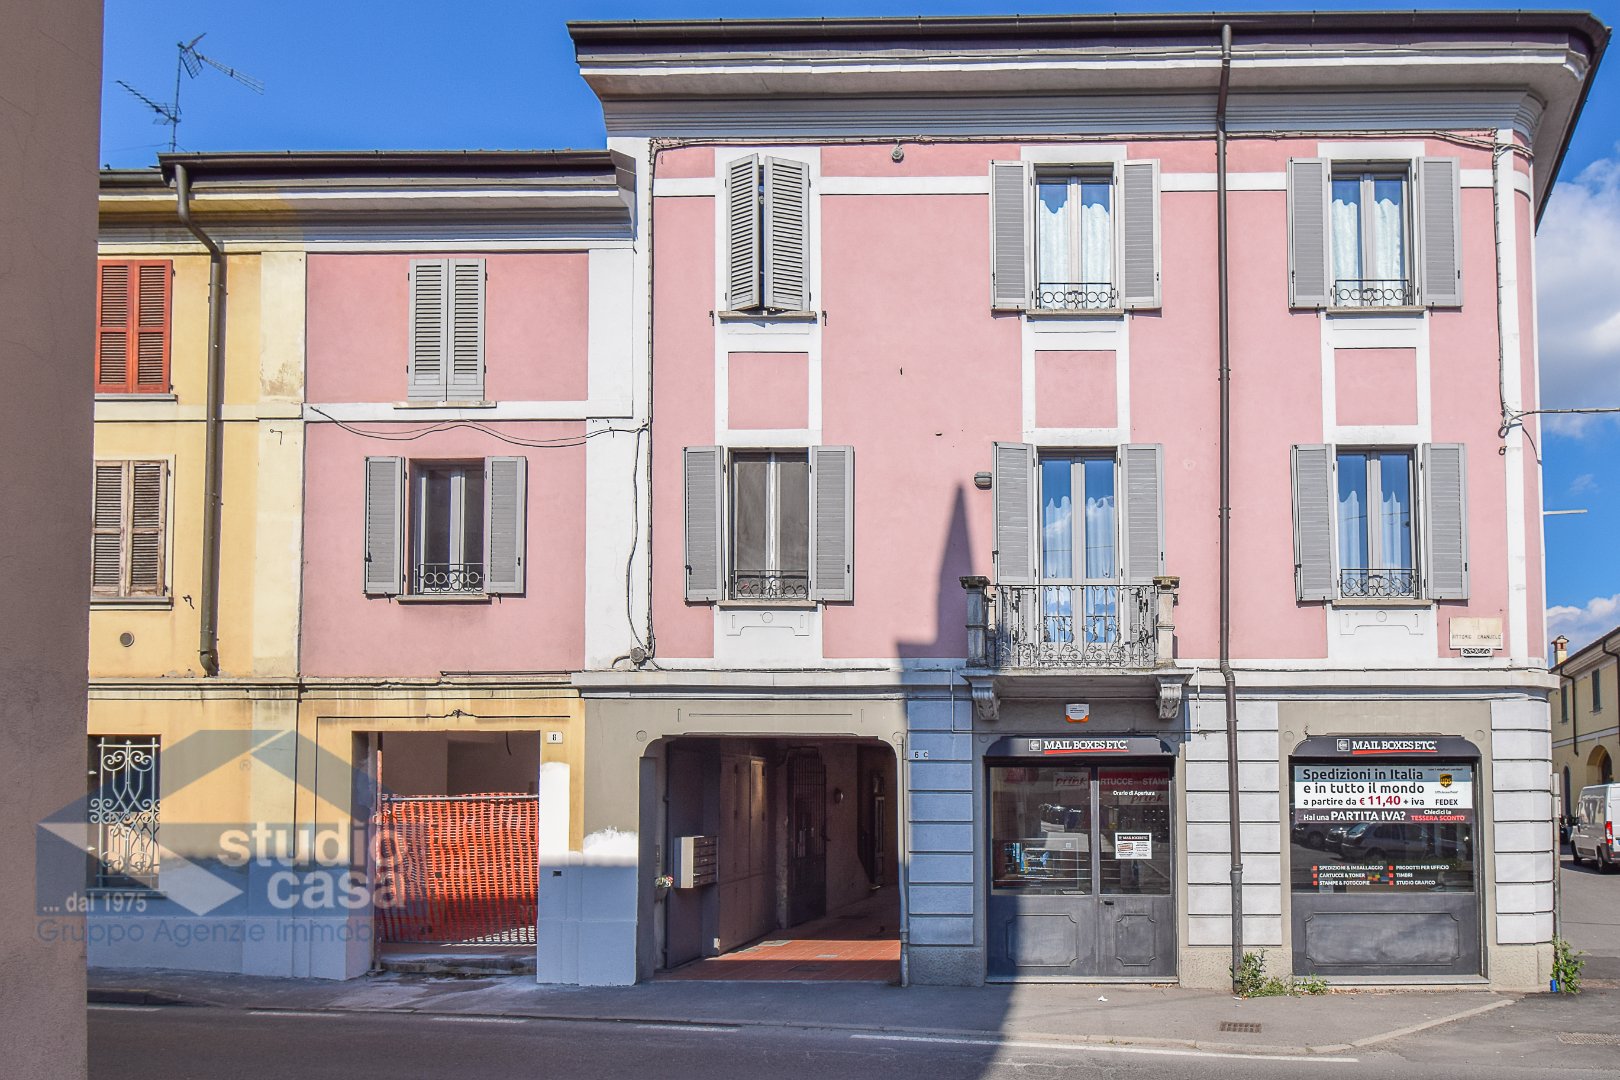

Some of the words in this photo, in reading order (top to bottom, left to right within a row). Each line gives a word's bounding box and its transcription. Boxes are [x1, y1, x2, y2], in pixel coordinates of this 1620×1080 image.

[1043, 740, 1072, 750] MAIL
[1073, 740, 1105, 750] BOXES
[1352, 740, 1380, 750] MAIL
[1381, 740, 1413, 750] BOXES
[1303, 768, 1371, 782] Spedizioni
[1374, 768, 1386, 780] in
[1390, 768, 1423, 780] Italia
[1303, 785, 1311, 794] e
[1315, 782, 1327, 794] in
[1330, 783, 1365, 794] tutto
[1368, 782, 1377, 794] il
[1380, 782, 1424, 794] mondo
[1311, 797, 1344, 807] partire
[1345, 797, 1357, 806] da
[1359, 797, 1366, 806] €
[1368, 795, 1401, 808] 11,40
[1411, 797, 1425, 806] iva
[1435, 798, 1459, 806] FEDEX
[1303, 813, 1316, 821] Hai
[1330, 811, 1379, 821] PARTITA
[1381, 811, 1406, 821] IVA?
